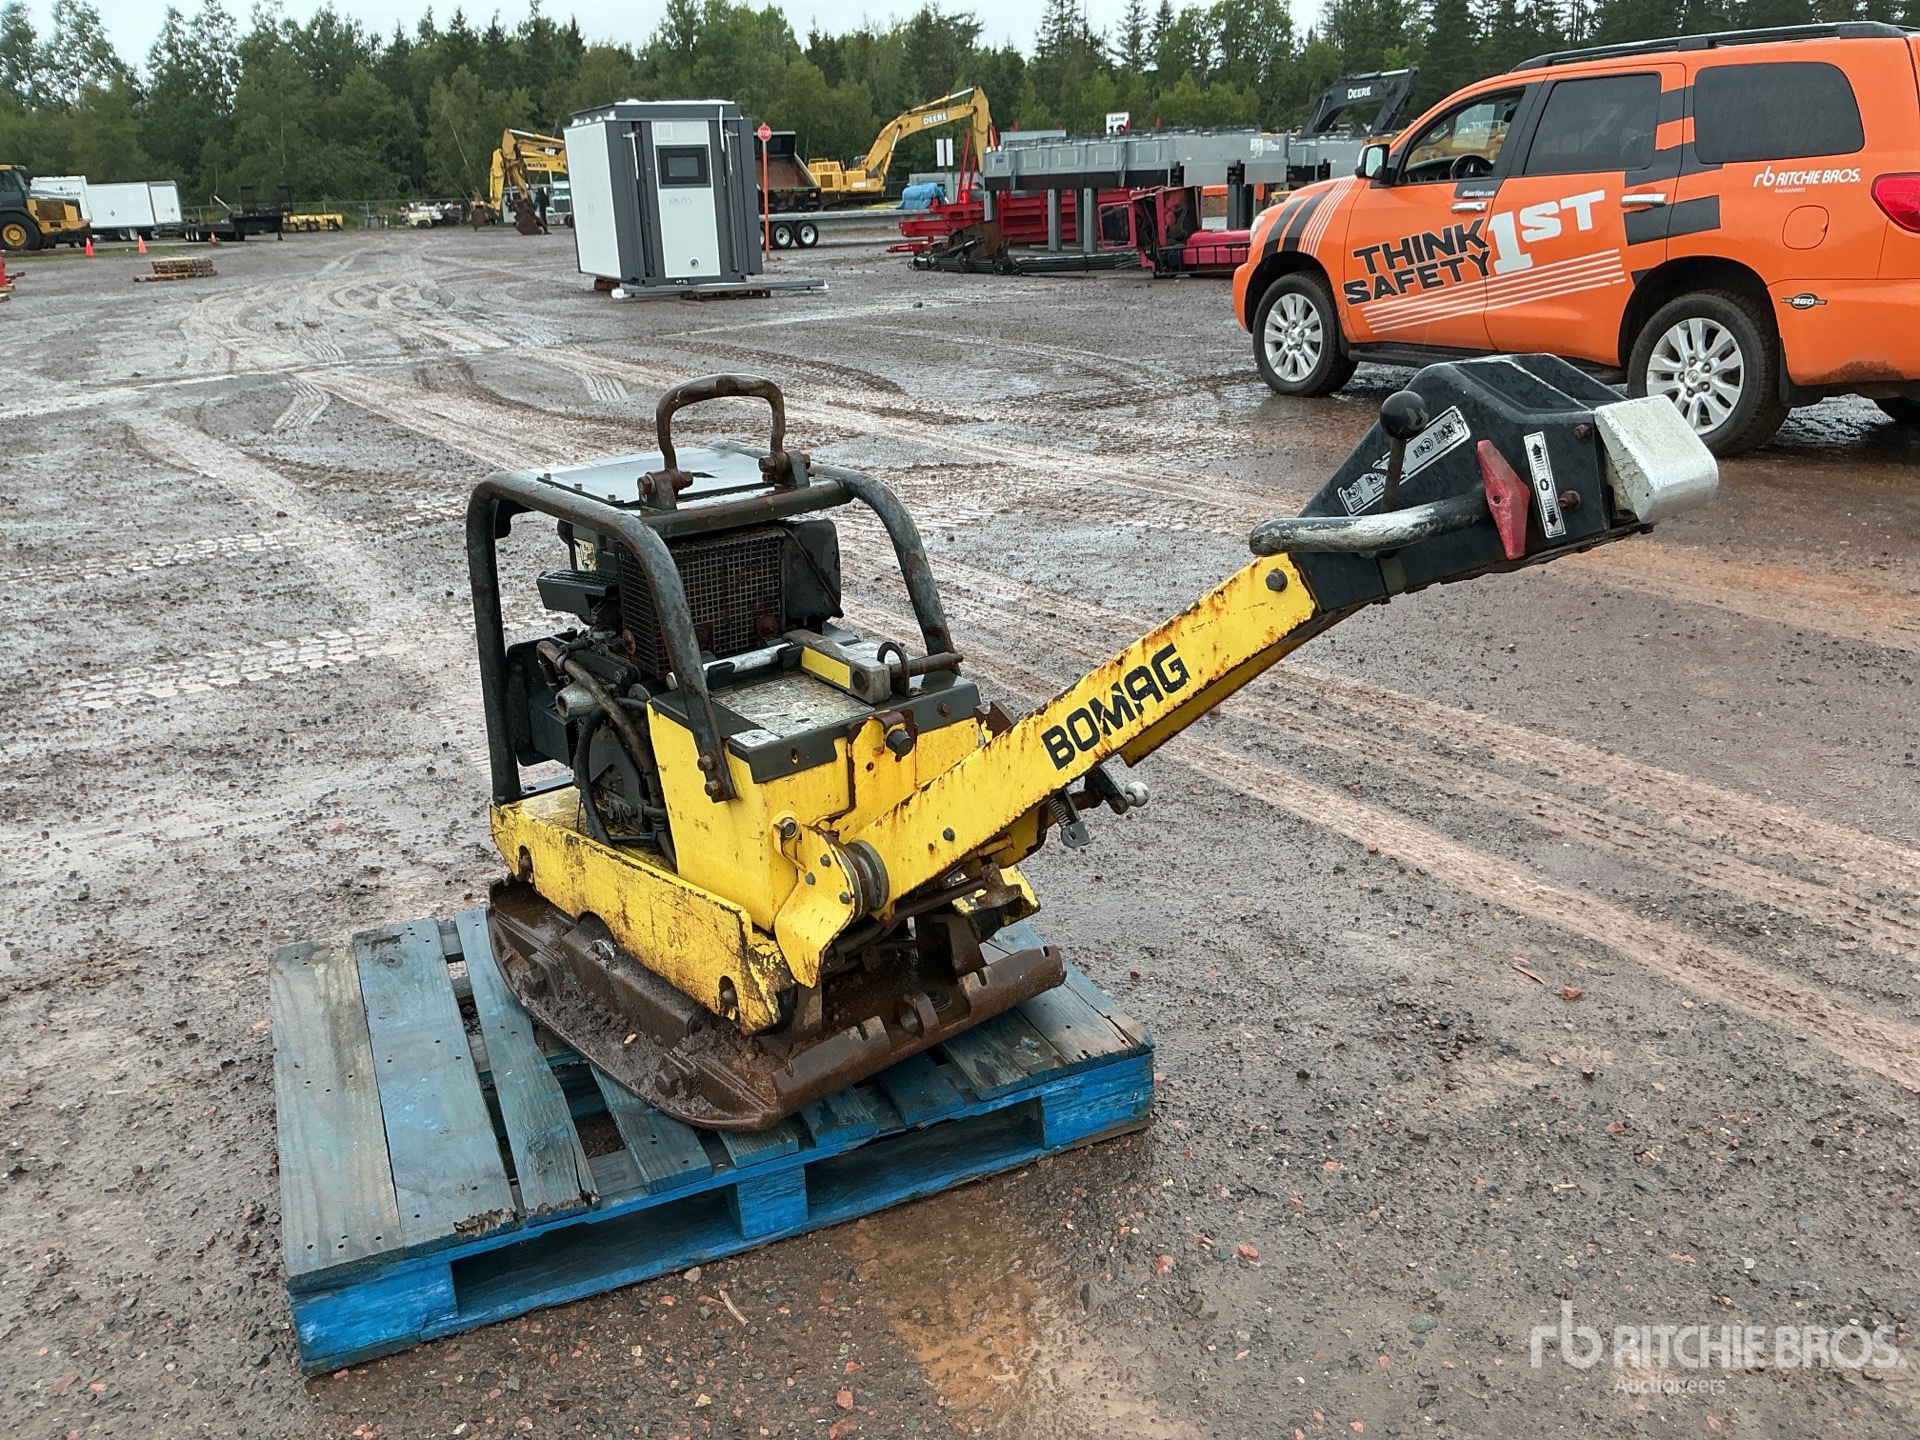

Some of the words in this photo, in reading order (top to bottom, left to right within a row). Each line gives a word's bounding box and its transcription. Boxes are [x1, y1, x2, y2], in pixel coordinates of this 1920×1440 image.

[1348, 86, 1372, 100] DEERE
[923, 112, 947, 125] DEERE
[545, 147, 556, 156] CAT
[1753, 166, 1776, 188] rb
[1776, 169, 1822, 186] RITCHIE
[1822, 167, 1861, 184] BROS.
[1487, 189, 1606, 275] 1ST
[1352, 218, 1490, 275] THINK
[1343, 250, 1491, 305] SAFETY
[1792, 297, 1815, 305] 360
[1041, 643, 1191, 770] BOMAG
